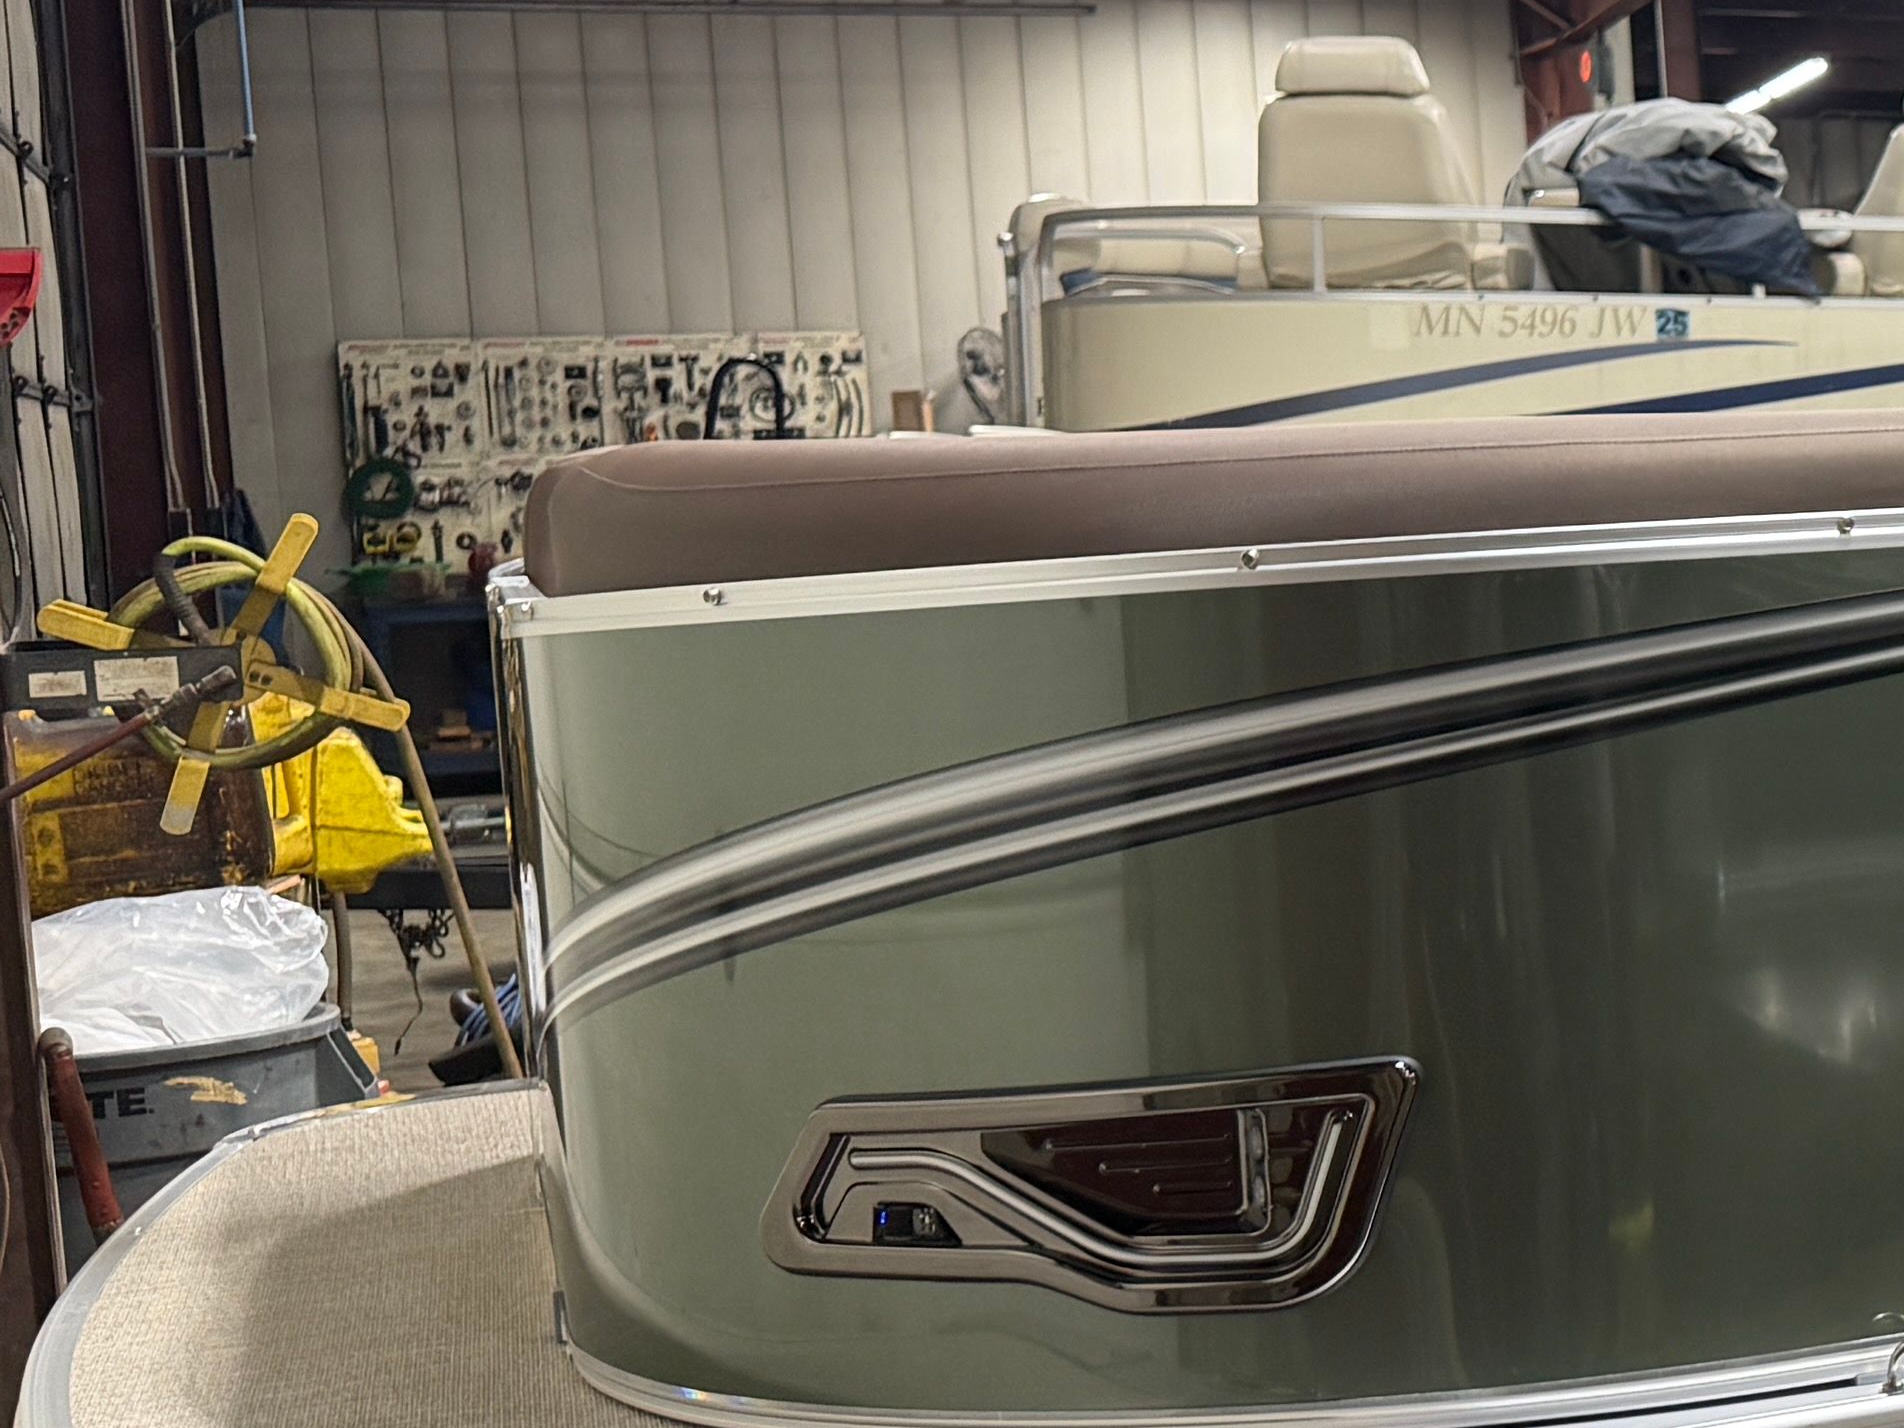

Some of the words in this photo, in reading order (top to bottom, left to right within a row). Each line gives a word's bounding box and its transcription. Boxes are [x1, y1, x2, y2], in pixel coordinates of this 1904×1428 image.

[1412, 303, 1486, 337] MN
[1497, 304, 1578, 339] 5496
[1589, 305, 1648, 339] JW
